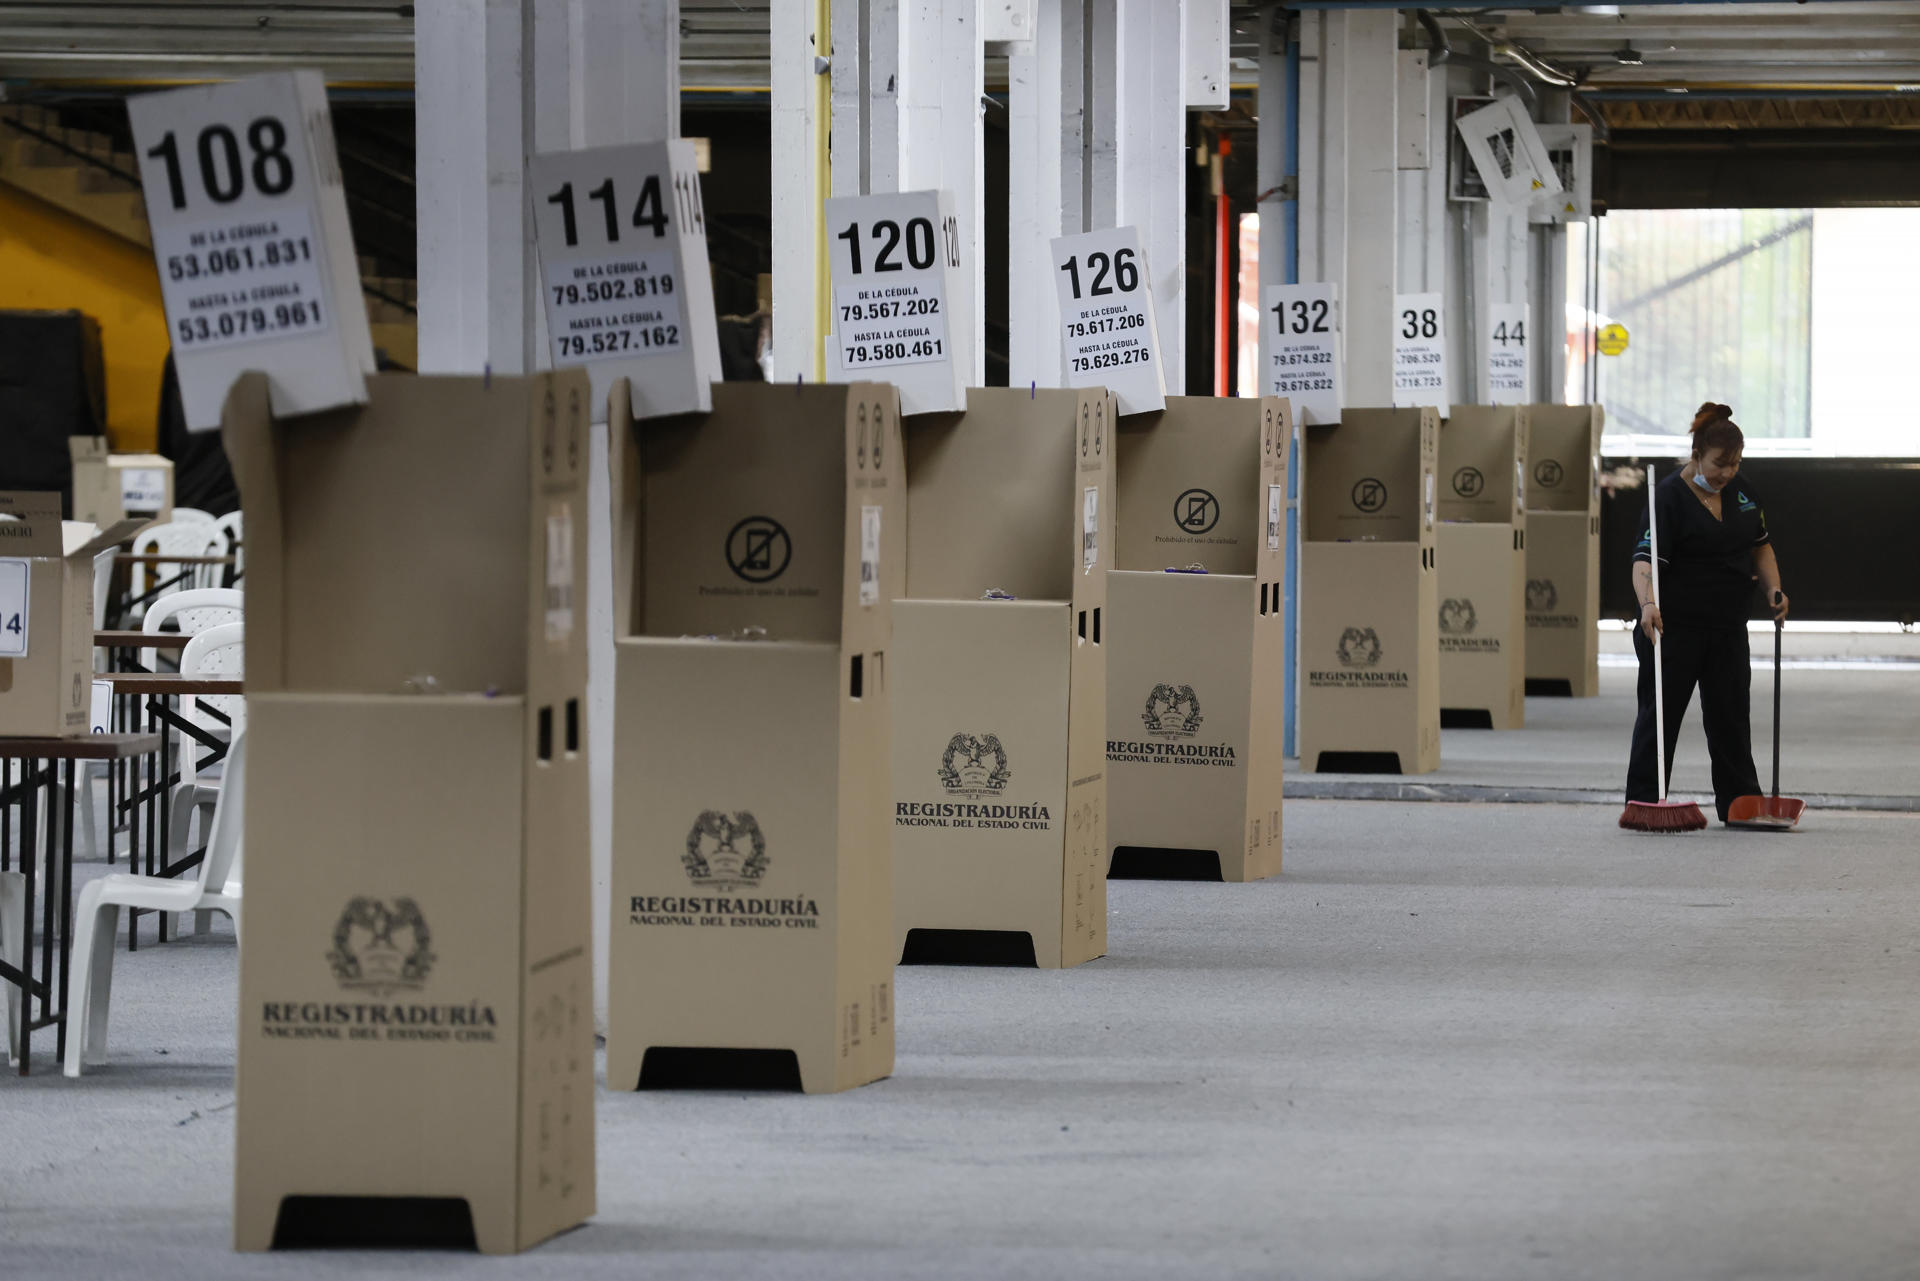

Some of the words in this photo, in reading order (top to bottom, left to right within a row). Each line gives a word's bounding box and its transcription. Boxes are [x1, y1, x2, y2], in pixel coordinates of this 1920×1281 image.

[147, 116, 294, 210] 108
[548, 175, 668, 246] 114
[838, 217, 935, 275] 120
[168, 237, 311, 281] 53.061.831
[574, 268, 587, 279] DE
[591, 265, 603, 276] LA
[1060, 248, 1139, 299] 126
[552, 274, 673, 307] 79.502.819
[858, 290, 869, 300] DE
[872, 289, 883, 299] LA
[178, 300, 321, 343] 53.079.961
[569, 316, 602, 330] HASTA
[605, 314, 618, 327] LA
[841, 298, 940, 322] 79.567.202
[1080, 310, 1089, 319] DE
[1091, 308, 1100, 317] LA
[1271, 299, 1329, 335] 132
[854, 331, 882, 342] HASTA
[884, 329, 894, 339] LA
[1067, 313, 1145, 337] 79.617.206
[1402, 309, 1438, 339] 38
[1493, 320, 1526, 346] 44
[558, 325, 679, 356] 79.527.162
[846, 339, 943, 363] 79.580.461
[1079, 344, 1101, 354] HASTA
[1102, 342, 1111, 351] LA
[1072, 348, 1150, 372] 79.629.276
[1106, 741, 1236, 759] REGISTRADURÍA
[1106, 754, 1151, 763] NACIONAL
[1153, 756, 1174, 764] DEL
[1174, 757, 1210, 766] ESTADO
[1212, 758, 1236, 767] CIVIL
[896, 802, 1050, 820] REGISTRADURÍA
[896, 818, 949, 828] NACIONAL
[953, 819, 974, 828] DEL
[977, 820, 1020, 830] ESTADO
[1022, 821, 1050, 831] CIVIL
[630, 894, 819, 916] REGISTRADURÍA
[630, 914, 695, 926] NACIONAL
[700, 916, 726, 927] DEL
[730, 916, 781, 929] ESTADO
[785, 918, 819, 930] CIVIL
[262, 1000, 497, 1026] REGISTRADURÍA
